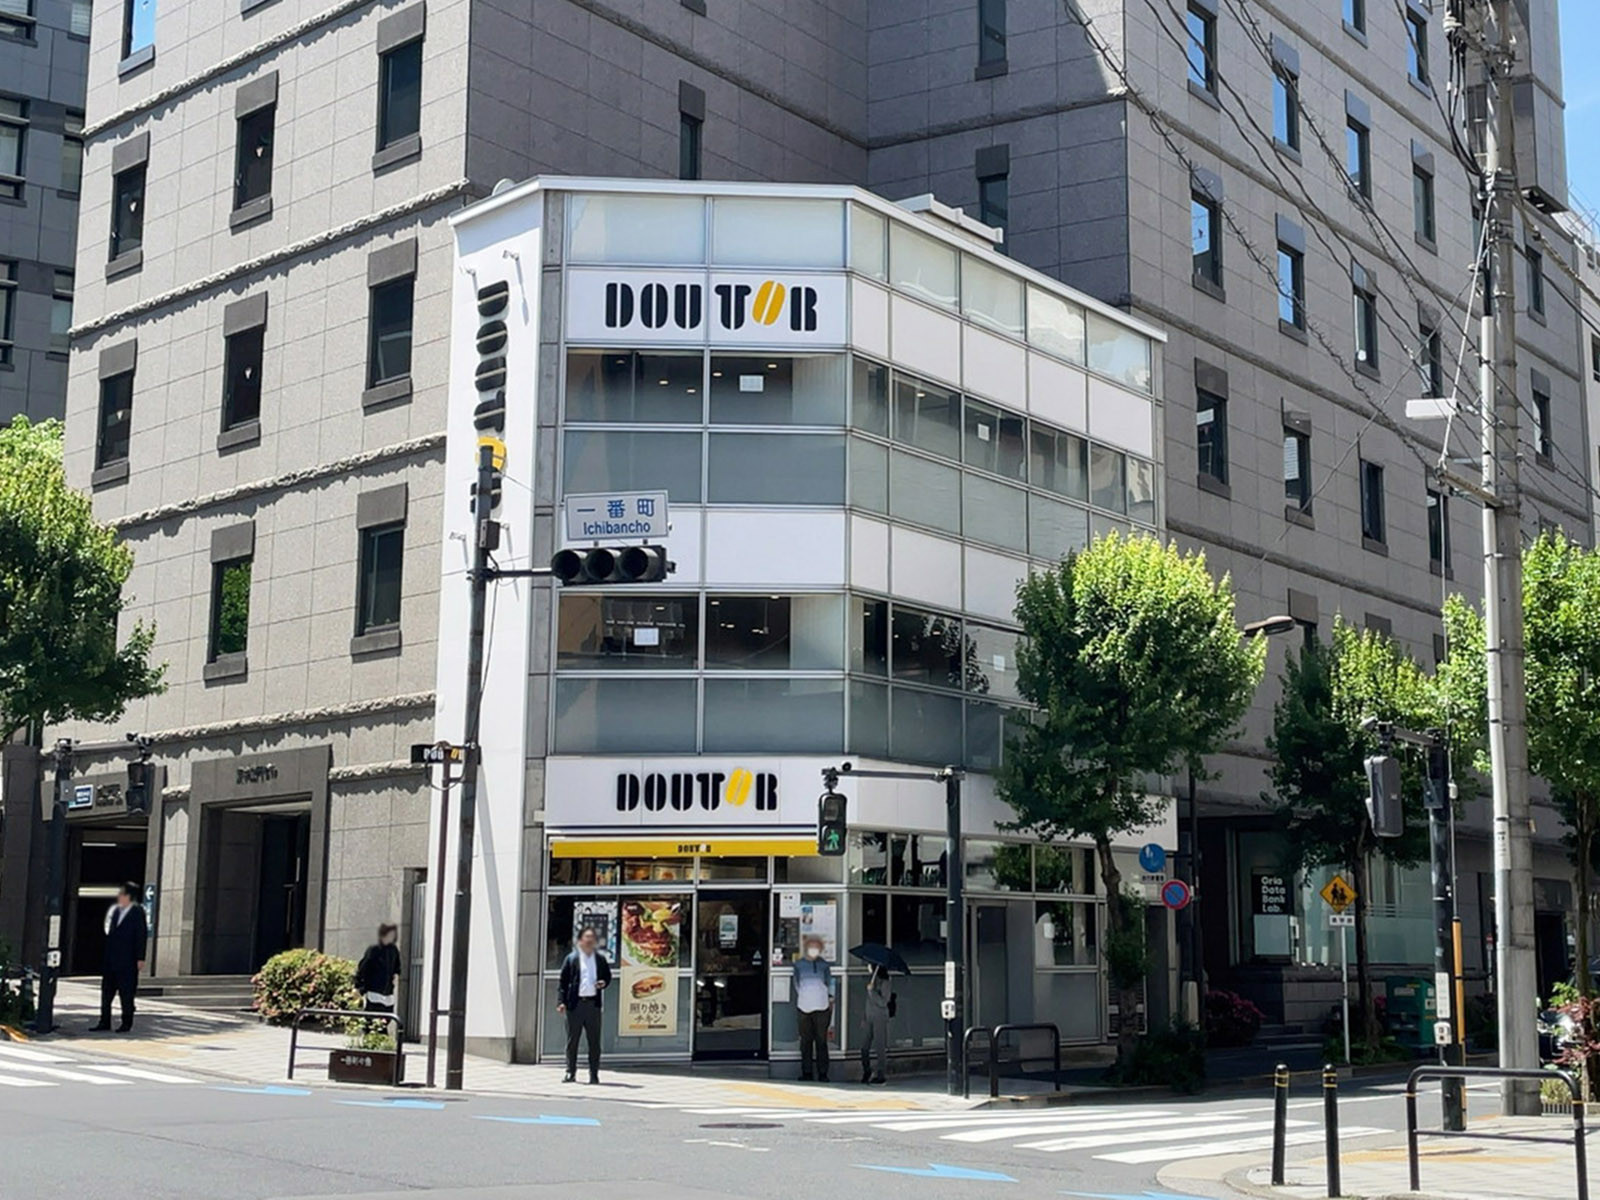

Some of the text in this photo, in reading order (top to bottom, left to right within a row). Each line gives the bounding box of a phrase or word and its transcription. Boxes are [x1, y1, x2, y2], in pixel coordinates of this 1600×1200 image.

[605, 281, 818, 331] DOUTOR
[577, 498, 655, 518] 一番町
[584, 519, 651, 535] Ichibancho
[617, 768, 778, 811] DOUTOR
[1261, 885, 1286, 894] Data
[630, 1003, 667, 1014] 照り焼き
[635, 1014, 662, 1023] チキン
